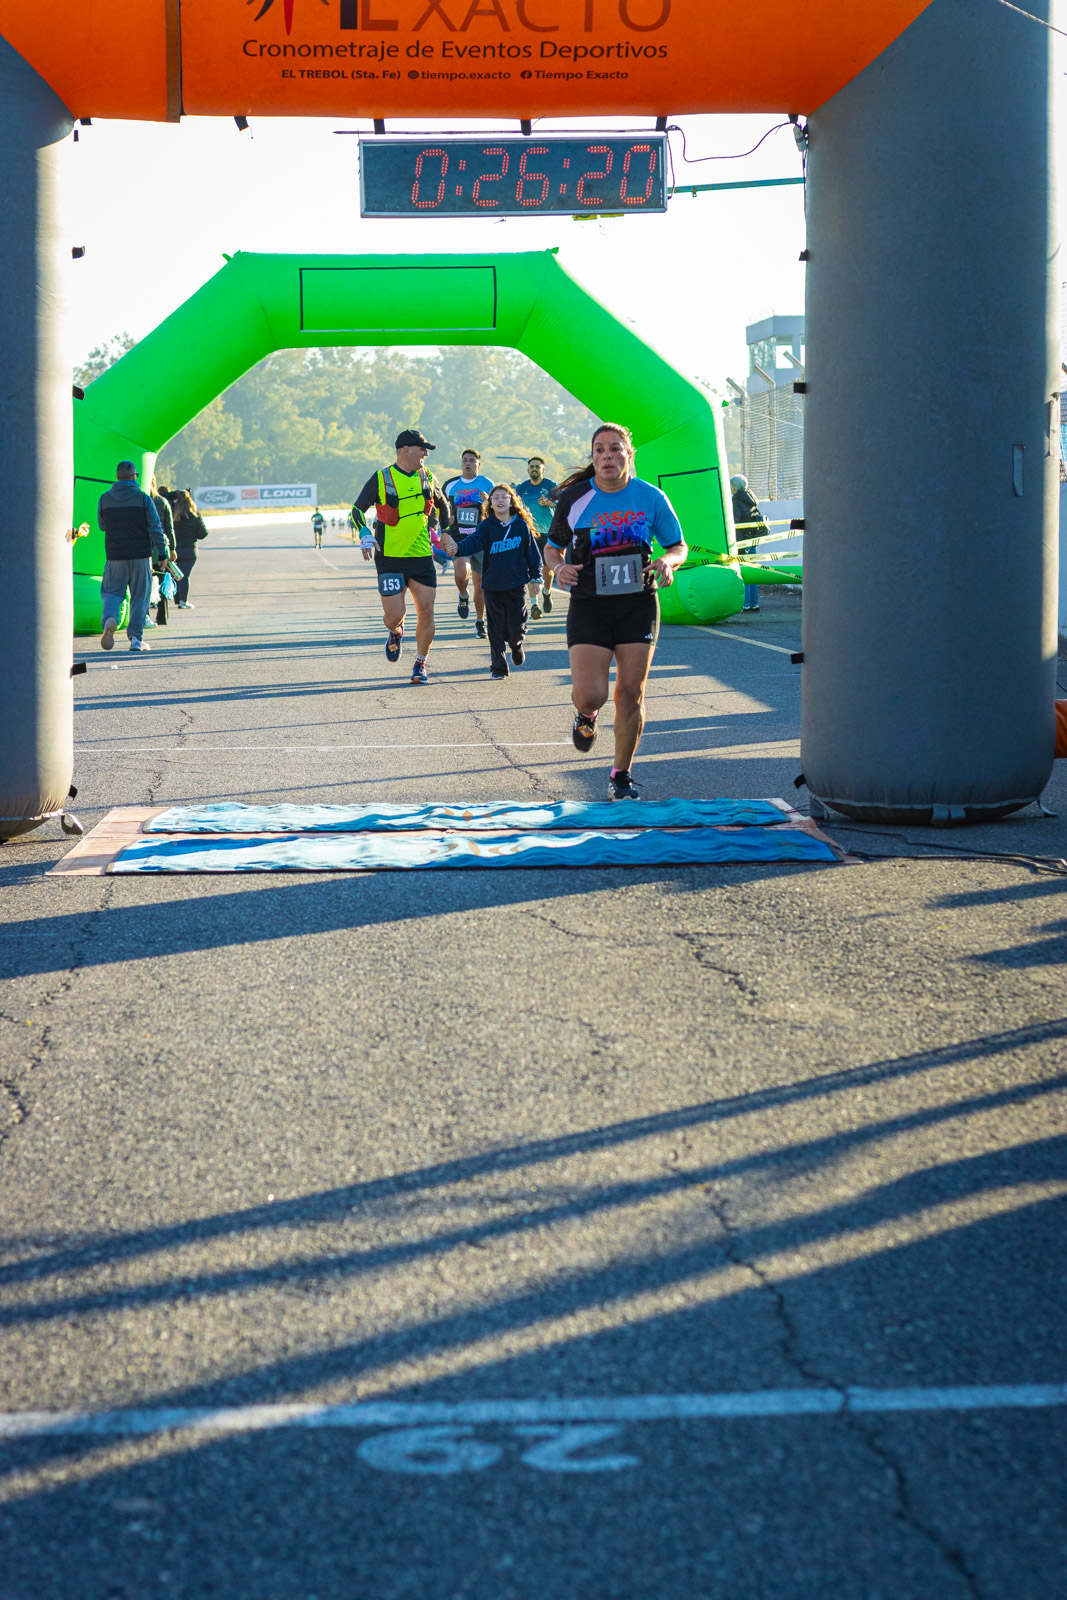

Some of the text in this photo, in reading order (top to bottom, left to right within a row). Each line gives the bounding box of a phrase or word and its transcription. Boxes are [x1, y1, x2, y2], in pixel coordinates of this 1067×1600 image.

[242, 39, 668, 62] Cronometraje de Eventos Deportivos
[281, 70, 401, 80] EL TREBOL (Sta. Fe)
[421, 70, 512, 81] tiempo.exacto
[534, 70, 629, 81] Tiempo Exacto
[411, 144, 657, 209] 0:26:20
[204, 491, 228, 502] Ford
[262, 489, 308, 498] LONG
[460, 511, 476, 522] 115
[610, 563, 631, 585] 71
[382, 578, 402, 592] 153
